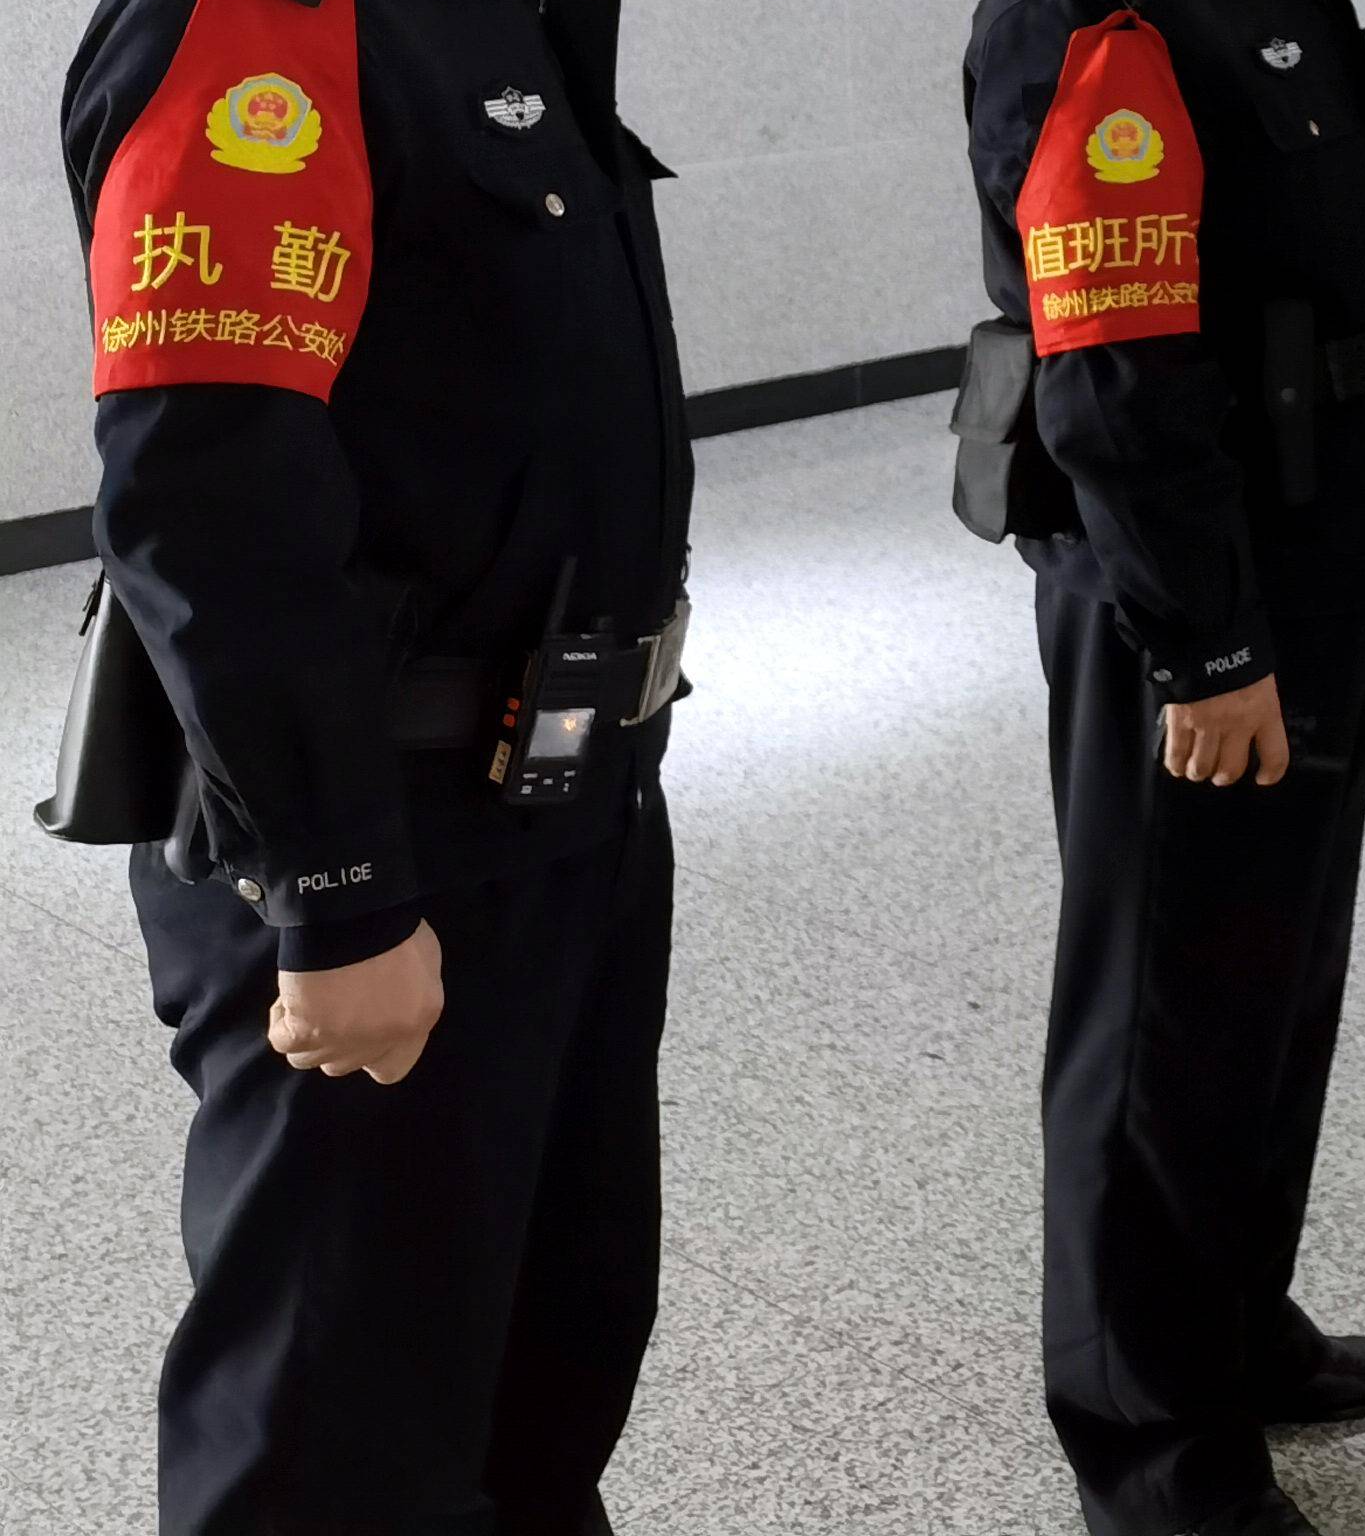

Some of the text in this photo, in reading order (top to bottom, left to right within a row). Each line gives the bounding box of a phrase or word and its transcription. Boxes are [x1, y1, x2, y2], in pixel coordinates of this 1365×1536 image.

[1027, 213, 1199, 282] 值班所
[1204, 646, 1253, 677] POLICE
[298, 862, 373, 894] POLICE
